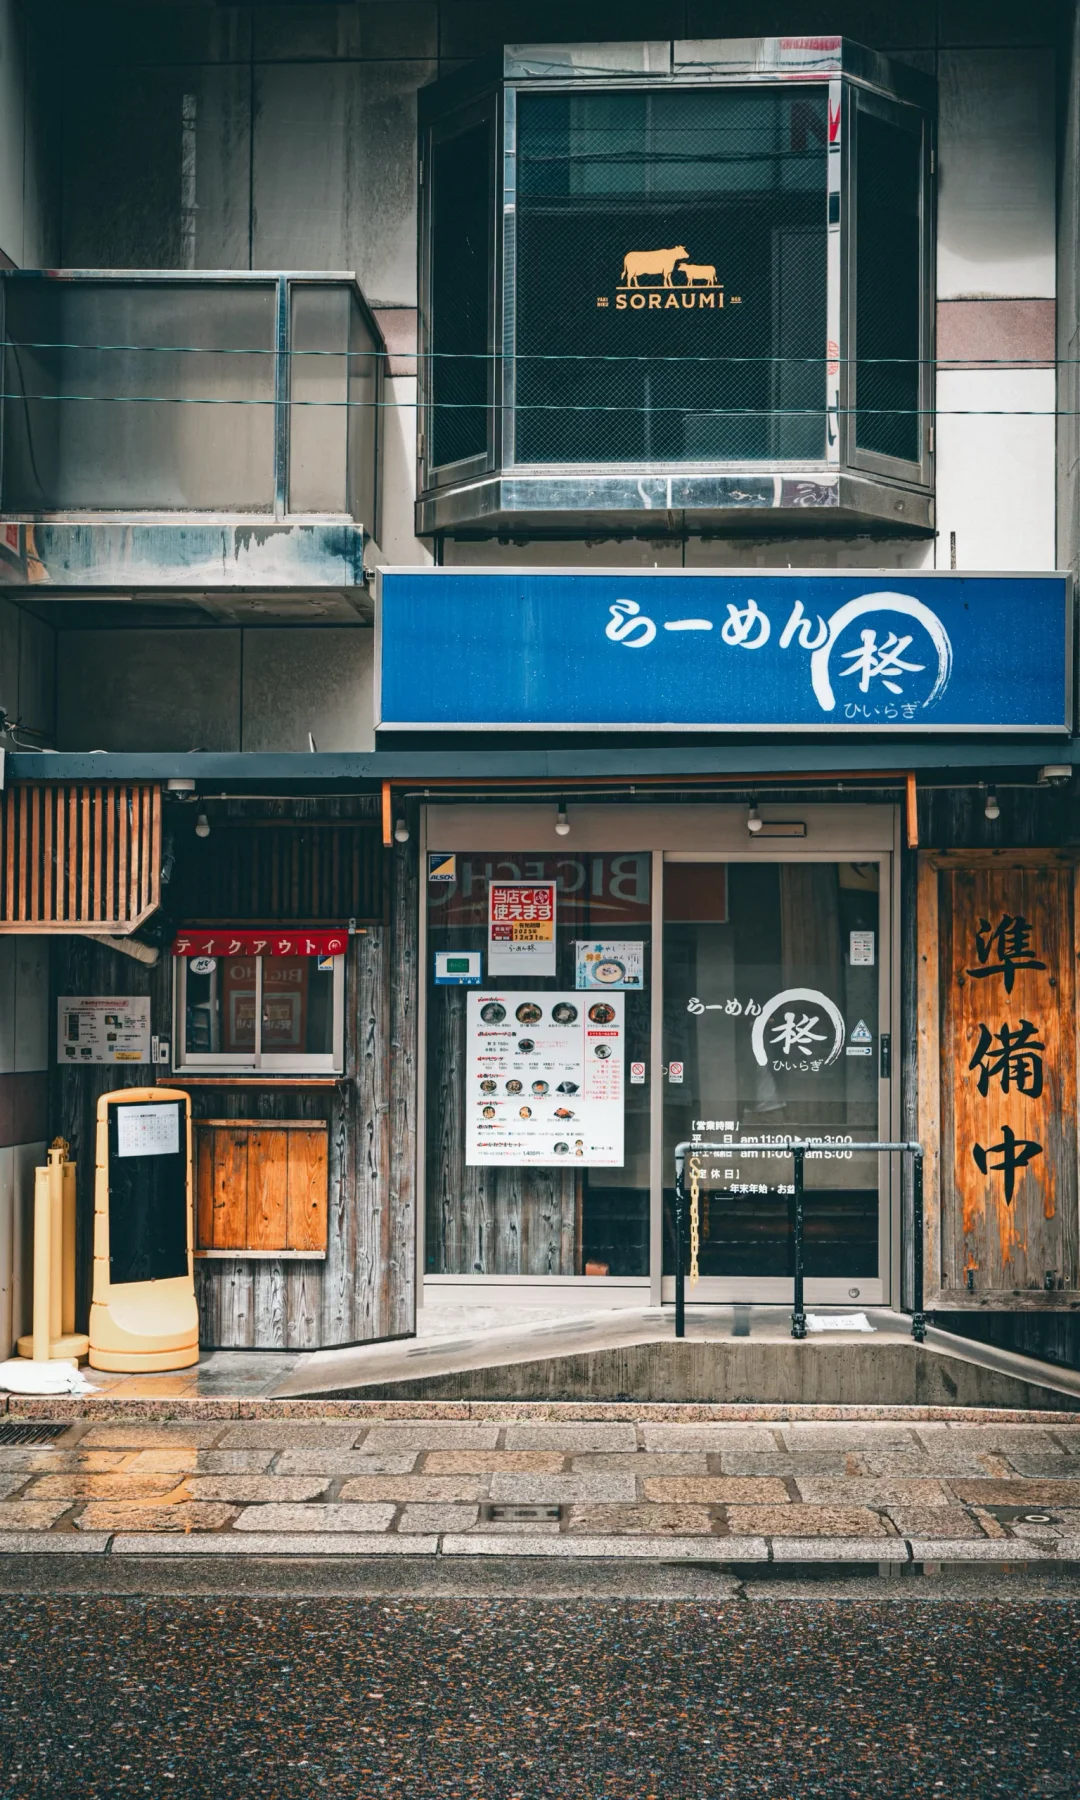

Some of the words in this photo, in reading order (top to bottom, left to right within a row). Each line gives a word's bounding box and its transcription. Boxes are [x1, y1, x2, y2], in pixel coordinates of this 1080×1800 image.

[615, 293, 724, 309] SORAUMI
[605, 599, 828, 649] らーめん
[838, 629, 926, 695] 柊
[844, 701, 920, 719] ひいらぎ
[493, 889, 533, 904] 当店で
[493, 904, 552, 920] 使えます
[176, 939, 317, 955] テイクアウト
[686, 997, 762, 1016] らーめん
[769, 1012, 828, 1056] 柊
[772, 1058, 824, 1072] ひいらぎ
[966, 913, 1047, 1207] 準備中
